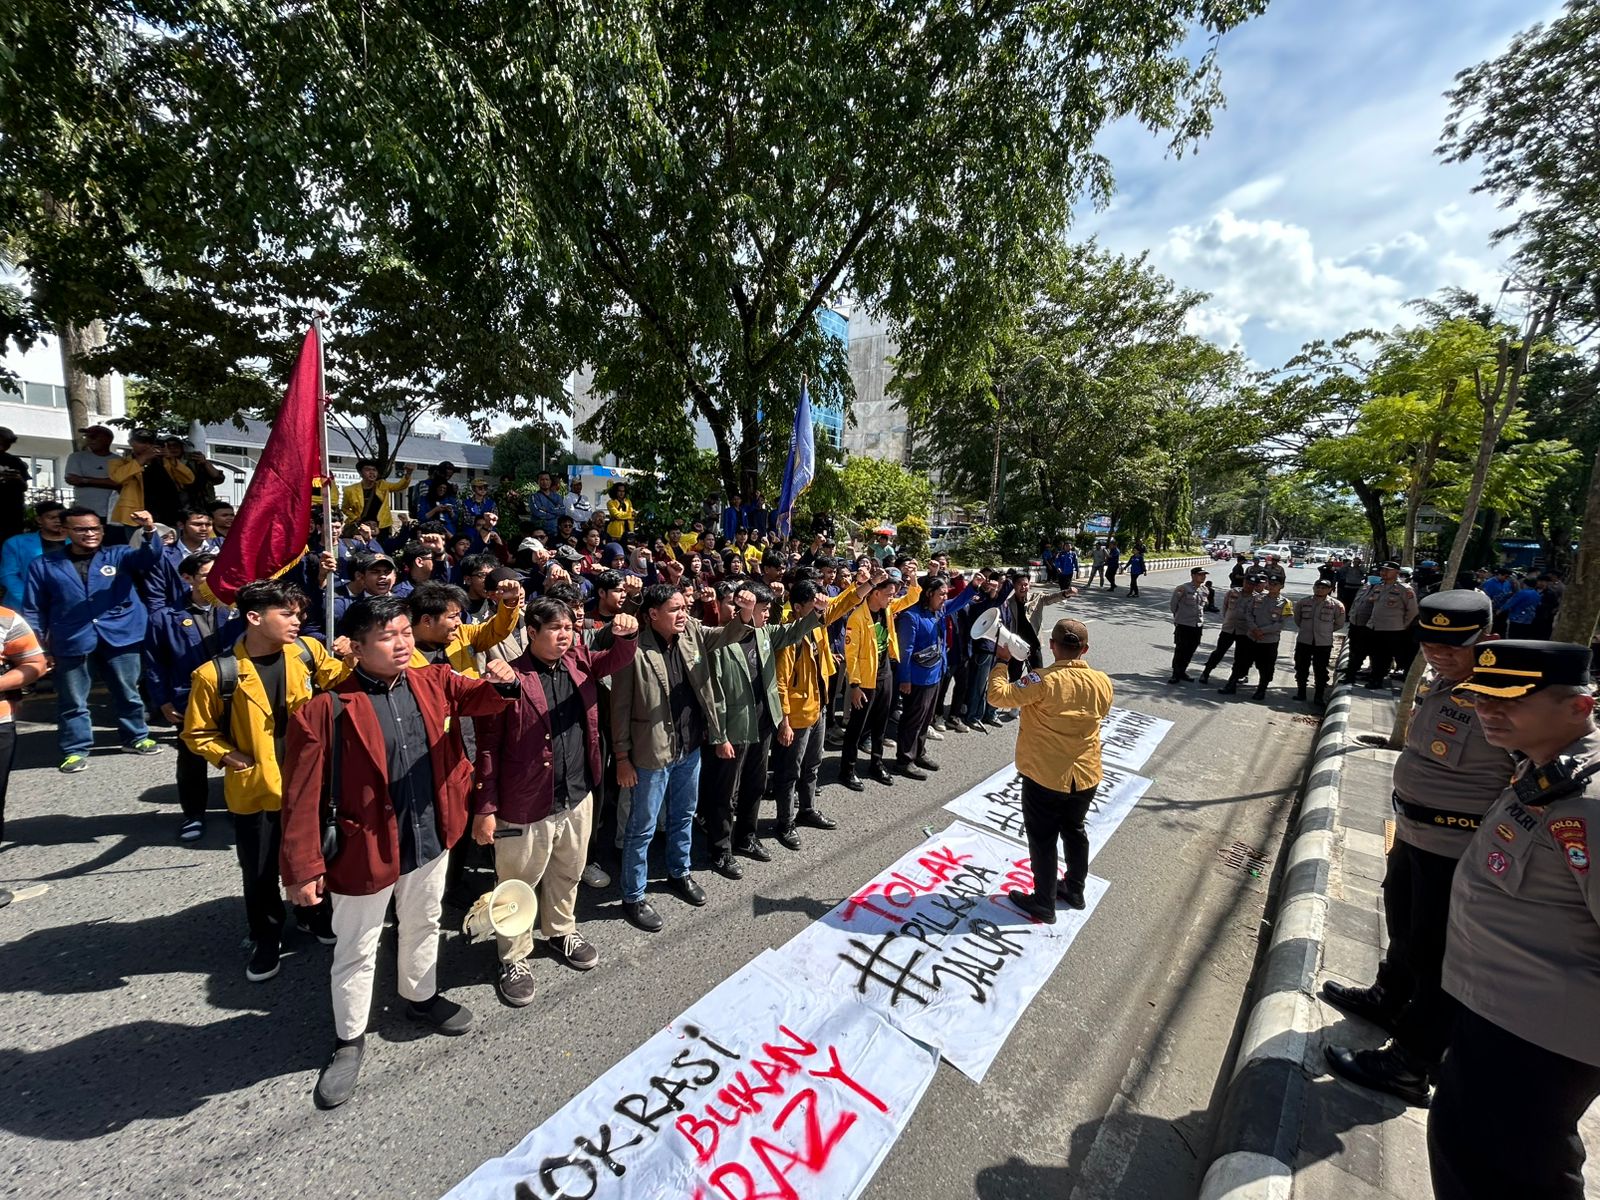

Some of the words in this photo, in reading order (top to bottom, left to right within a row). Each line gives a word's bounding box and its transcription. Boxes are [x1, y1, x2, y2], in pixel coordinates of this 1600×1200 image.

[1439, 705, 1472, 725] POLRI
[1446, 816, 1481, 829] POL
[1504, 802, 1538, 832] POLRI
[1551, 820, 1581, 832] POLDA
[840, 845, 973, 924] TOLAK
[932, 917, 1031, 1004] JALUR
[676, 1025, 817, 1165] BUKAN
[692, 1046, 891, 1200] RAZY
